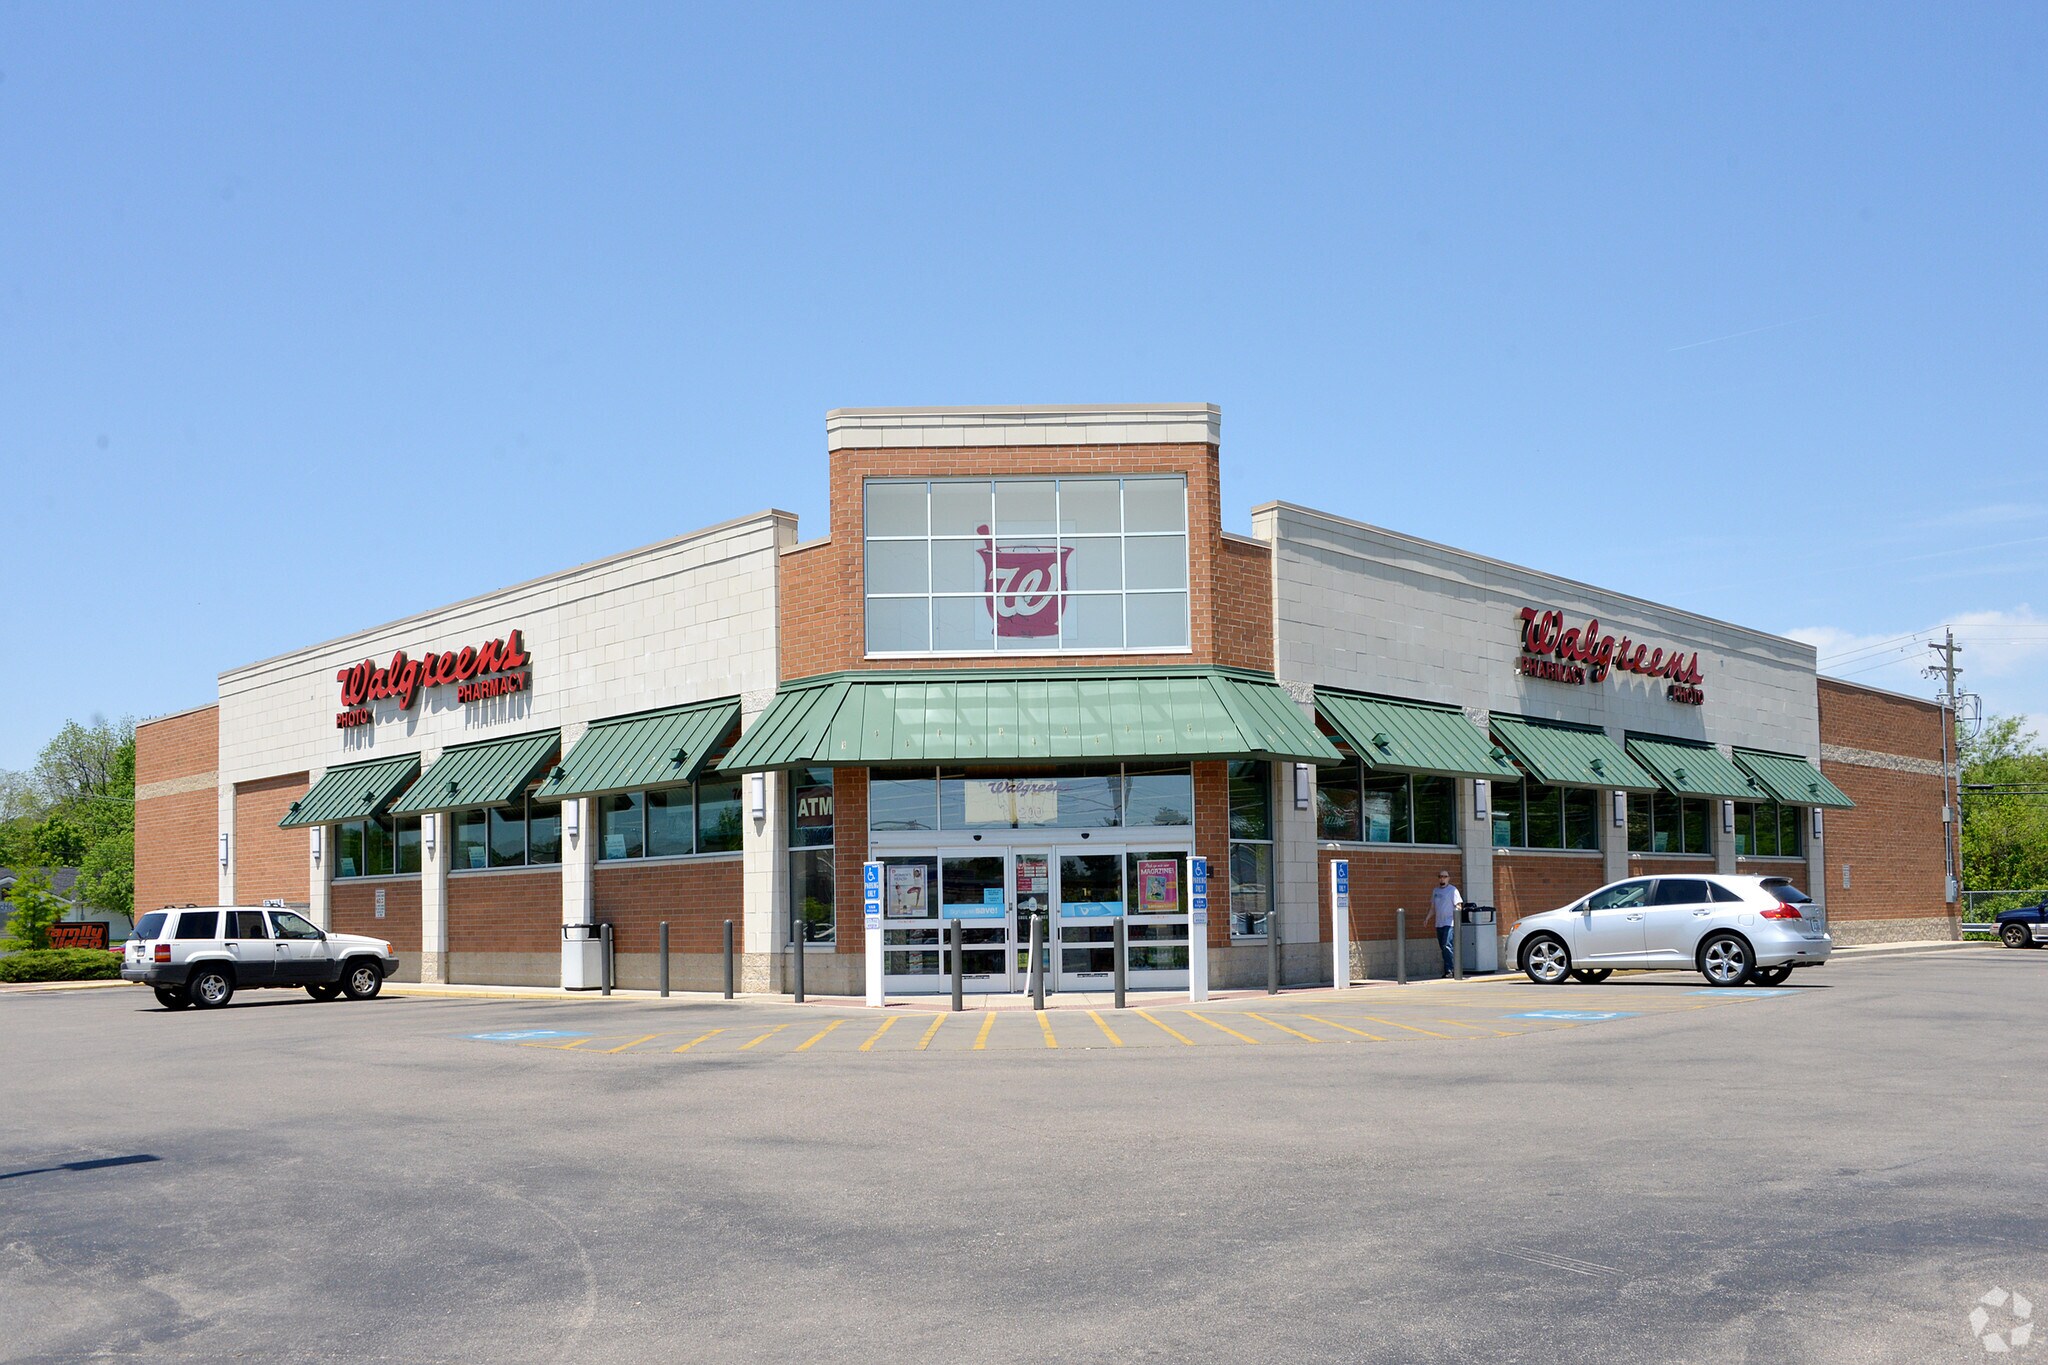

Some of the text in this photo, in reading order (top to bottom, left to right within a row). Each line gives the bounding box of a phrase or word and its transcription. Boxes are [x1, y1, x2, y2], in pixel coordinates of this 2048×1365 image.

[1520, 606, 1705, 685] Walgreens
[336, 629, 528, 711] Walgreens
[1520, 656, 1588, 685] PHARMACY
[457, 672, 528, 704] PHARMACY
[1672, 685, 1705, 706] PHOTO
[336, 707, 370, 729] PHOTO
[797, 796, 833, 818] ATM
[975, 907, 998, 915] save!
